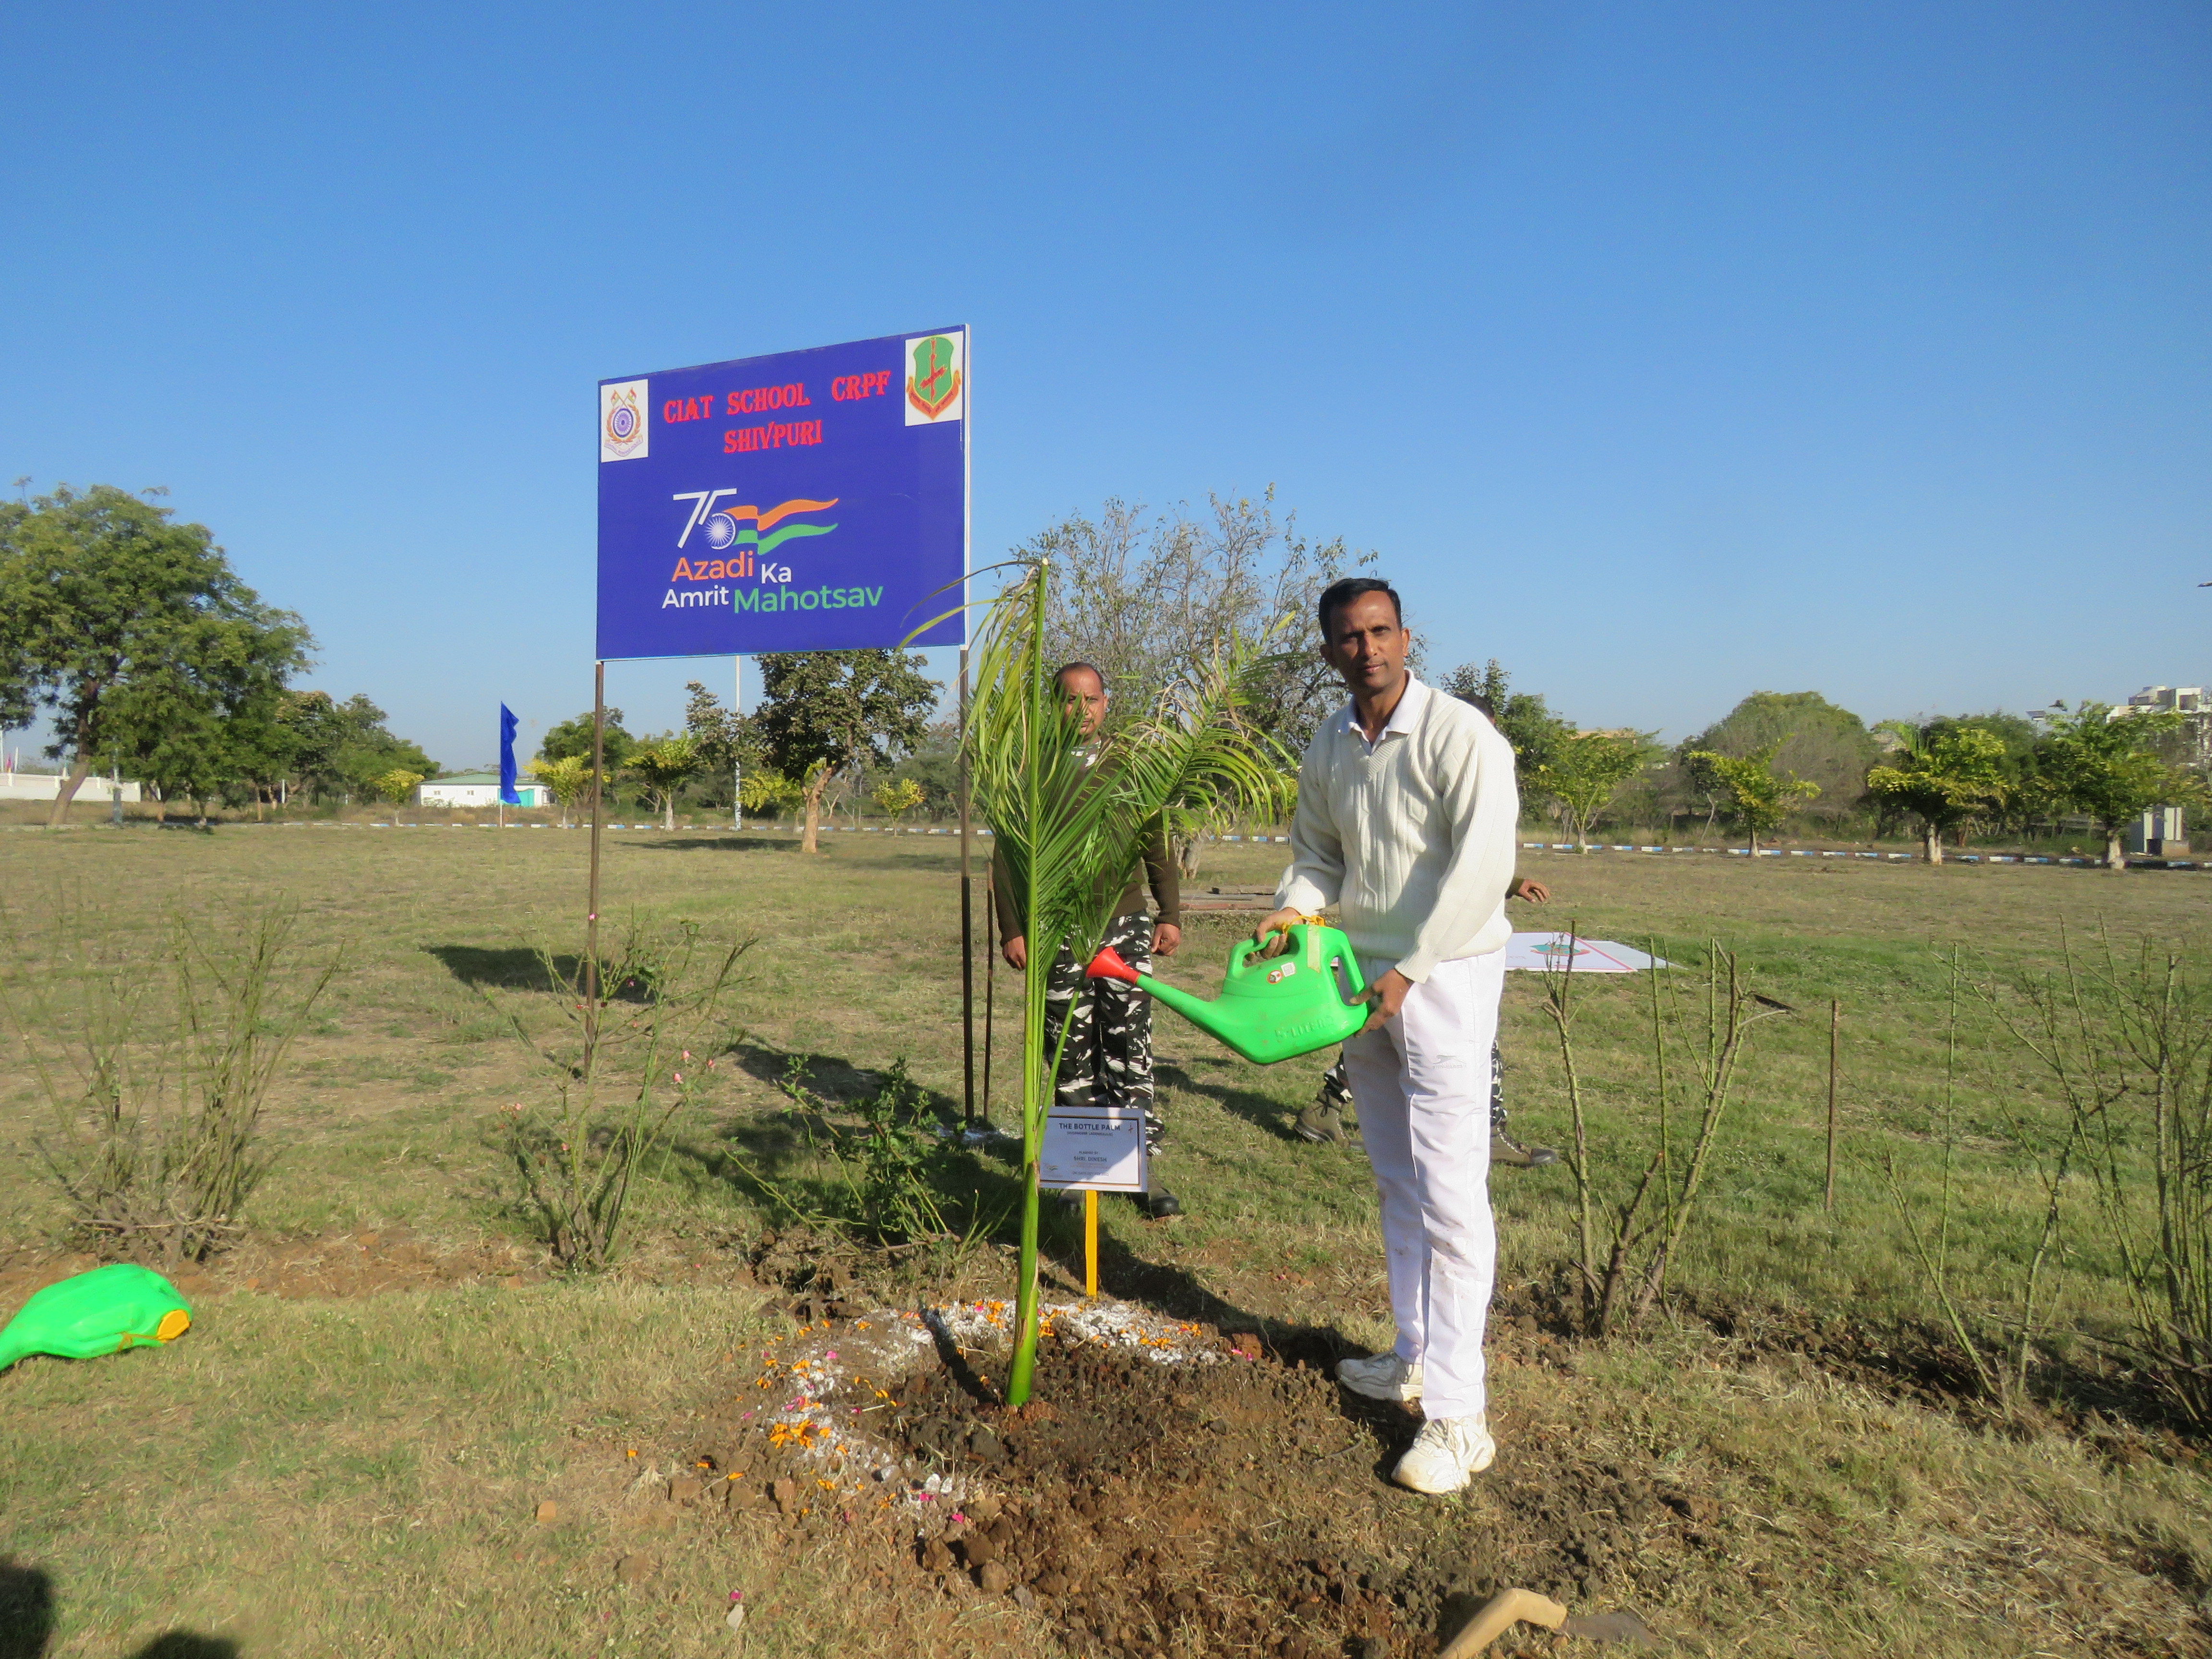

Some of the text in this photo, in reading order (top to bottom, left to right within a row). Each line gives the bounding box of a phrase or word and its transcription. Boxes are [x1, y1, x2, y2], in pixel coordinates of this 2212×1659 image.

[664, 371, 891, 423] CIAT SCHOOL CRPF
[724, 420, 822, 453] SHIVPURI
[672, 551, 791, 583] Azadi Ka
[662, 585, 883, 613] Amrit Mahotsav
